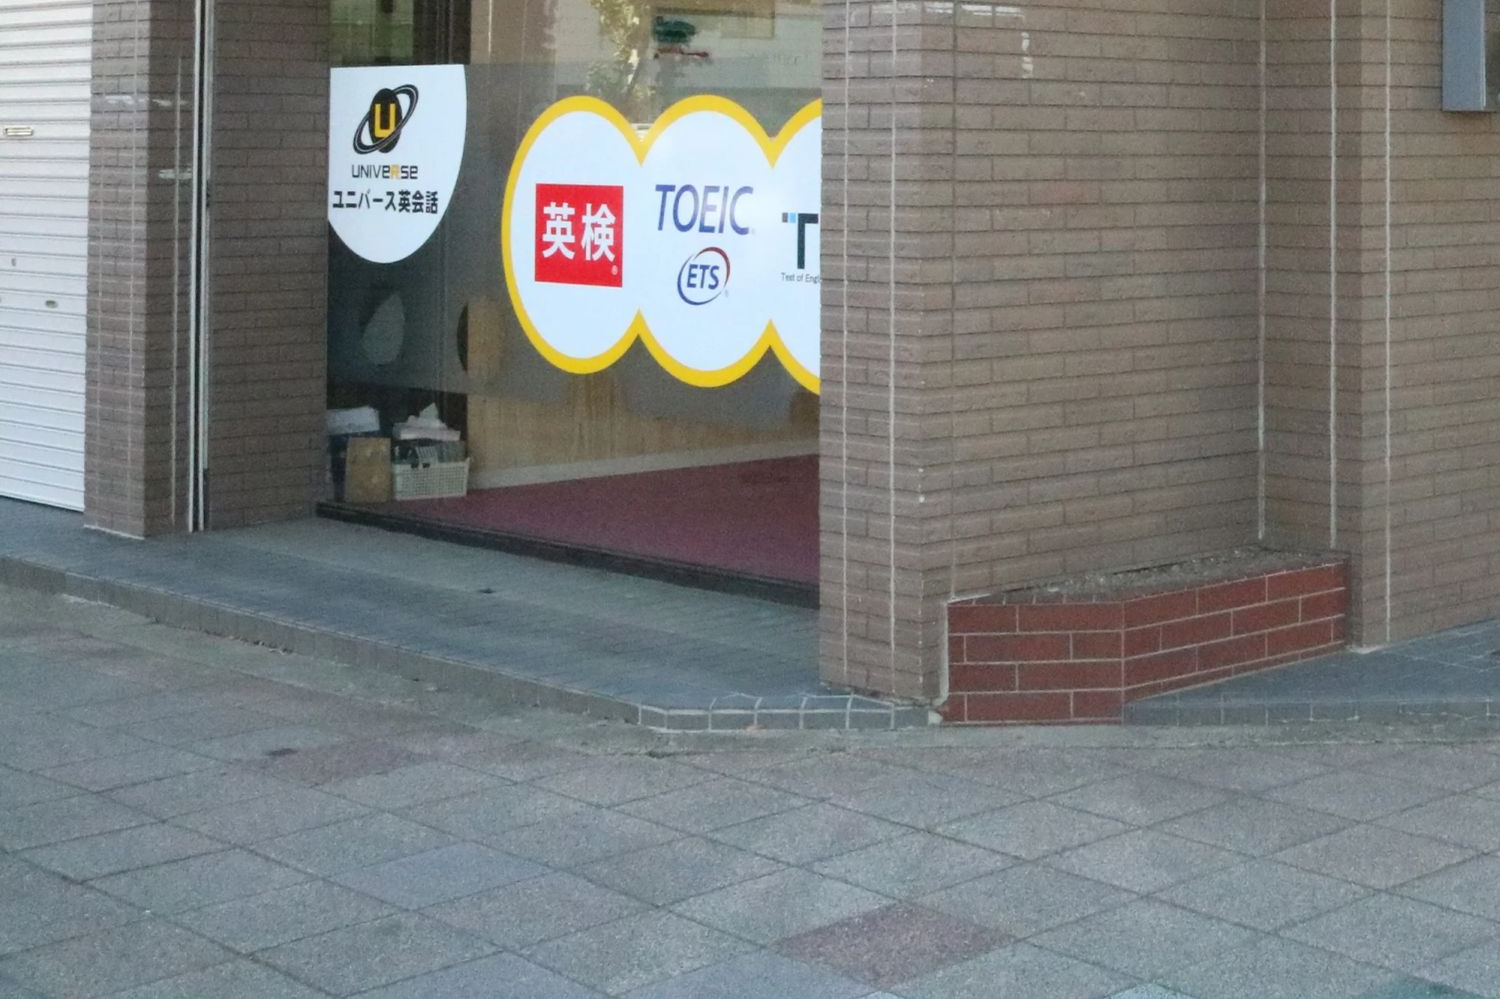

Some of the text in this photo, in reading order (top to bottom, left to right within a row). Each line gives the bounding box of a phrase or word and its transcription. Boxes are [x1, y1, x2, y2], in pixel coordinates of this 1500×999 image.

[332, 188, 438, 215] ユニバース英会話
[655, 184, 754, 236] TOEIC
[542, 201, 617, 262] 英検
[686, 263, 720, 290] ETS
